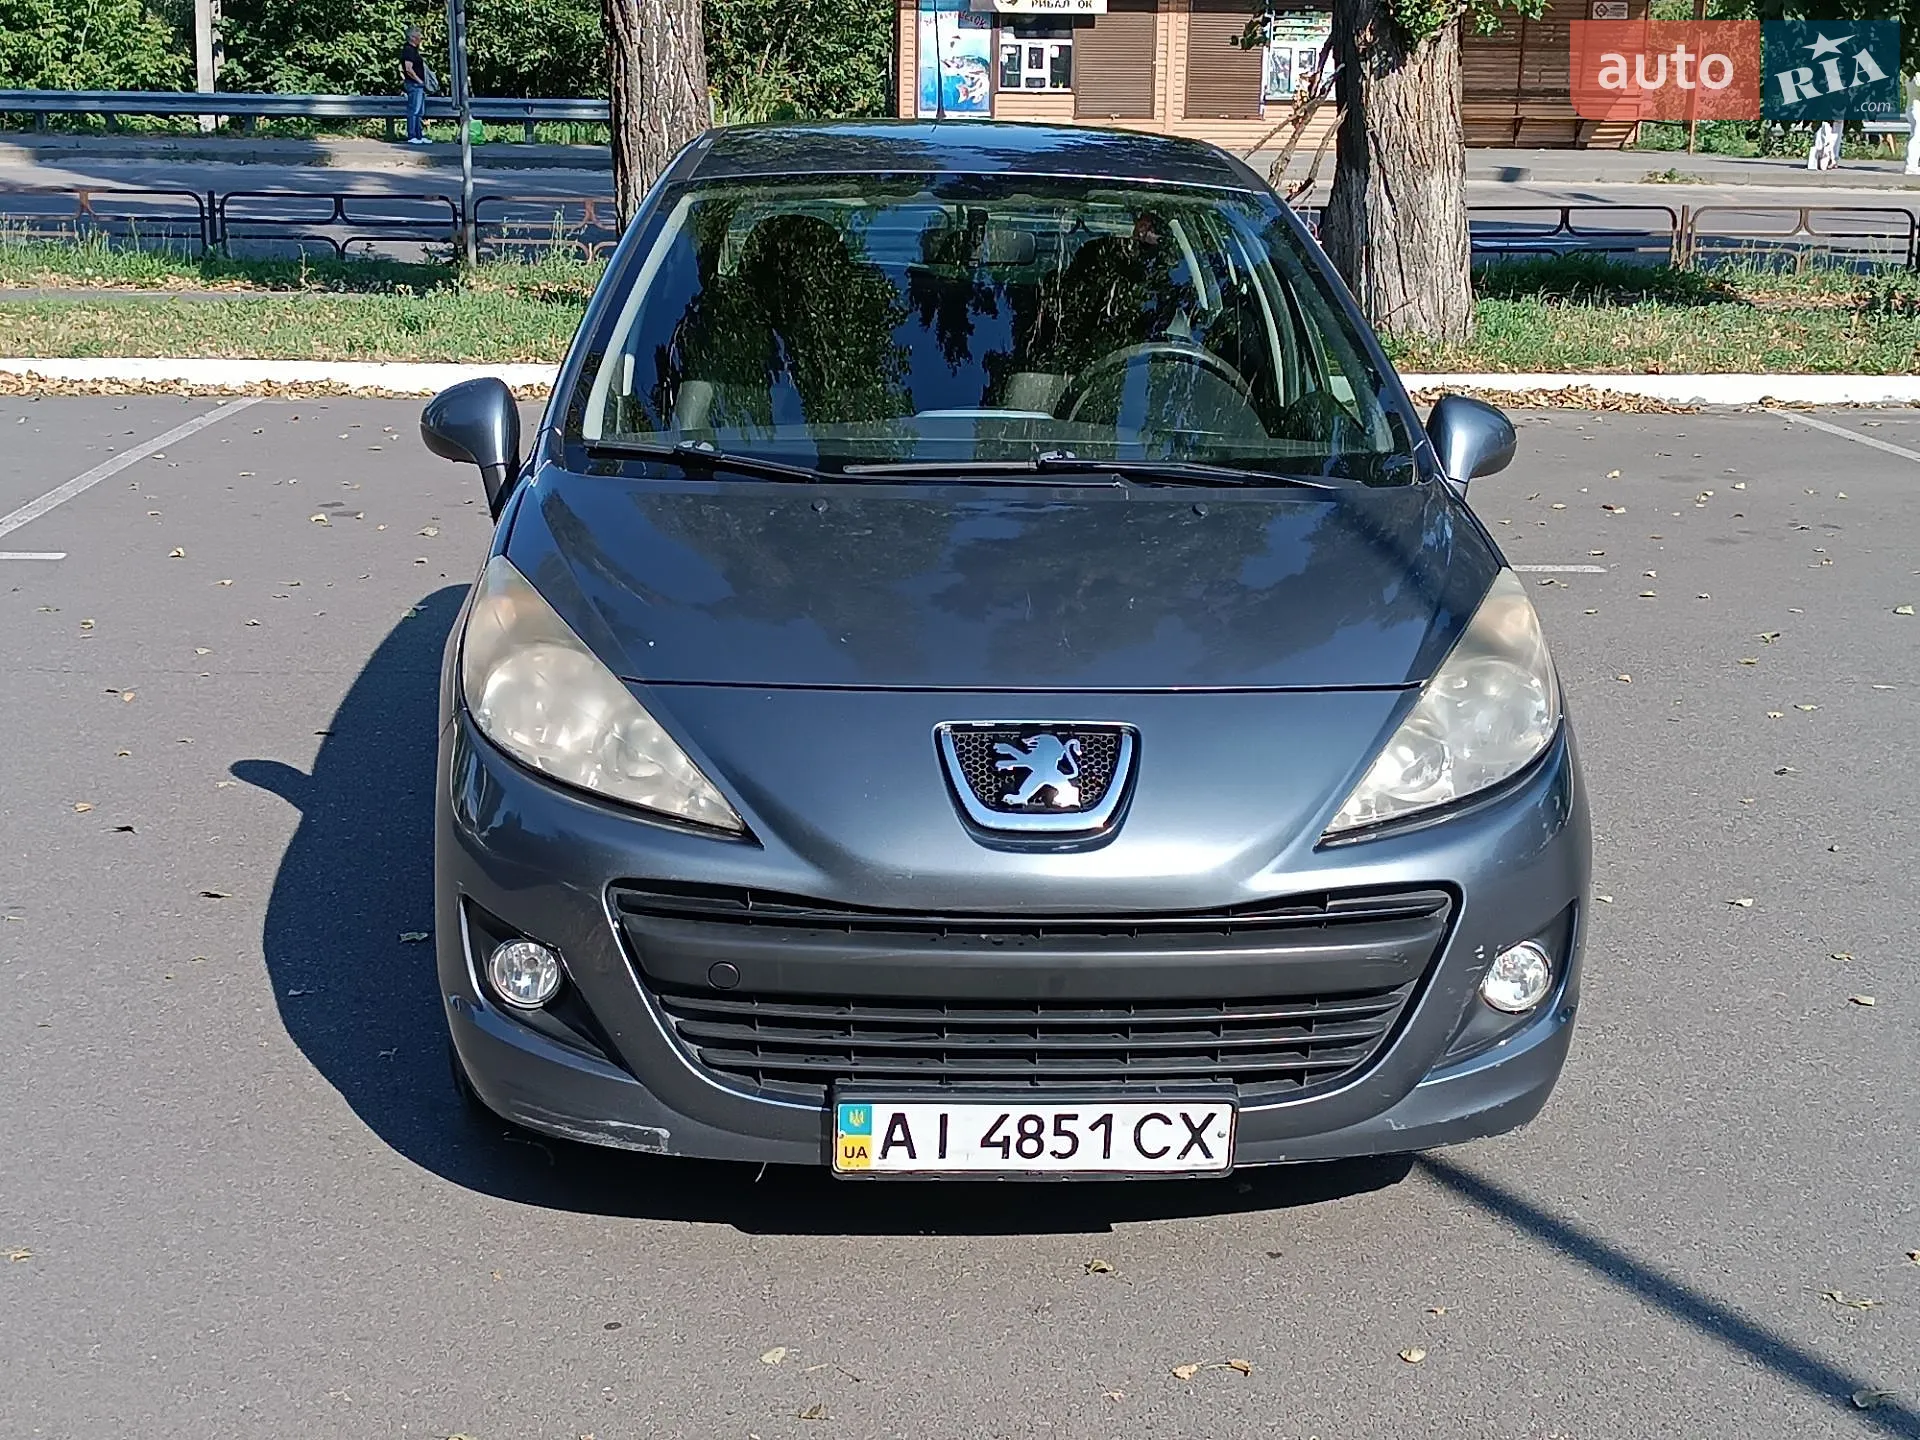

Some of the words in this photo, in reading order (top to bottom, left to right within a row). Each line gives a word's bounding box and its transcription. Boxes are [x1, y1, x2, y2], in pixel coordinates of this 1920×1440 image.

[879, 1112, 948, 1160] AI
[980, 1113, 1114, 1160] 4851
[1133, 1112, 1218, 1160] CX
[843, 1145, 868, 1159] UA
